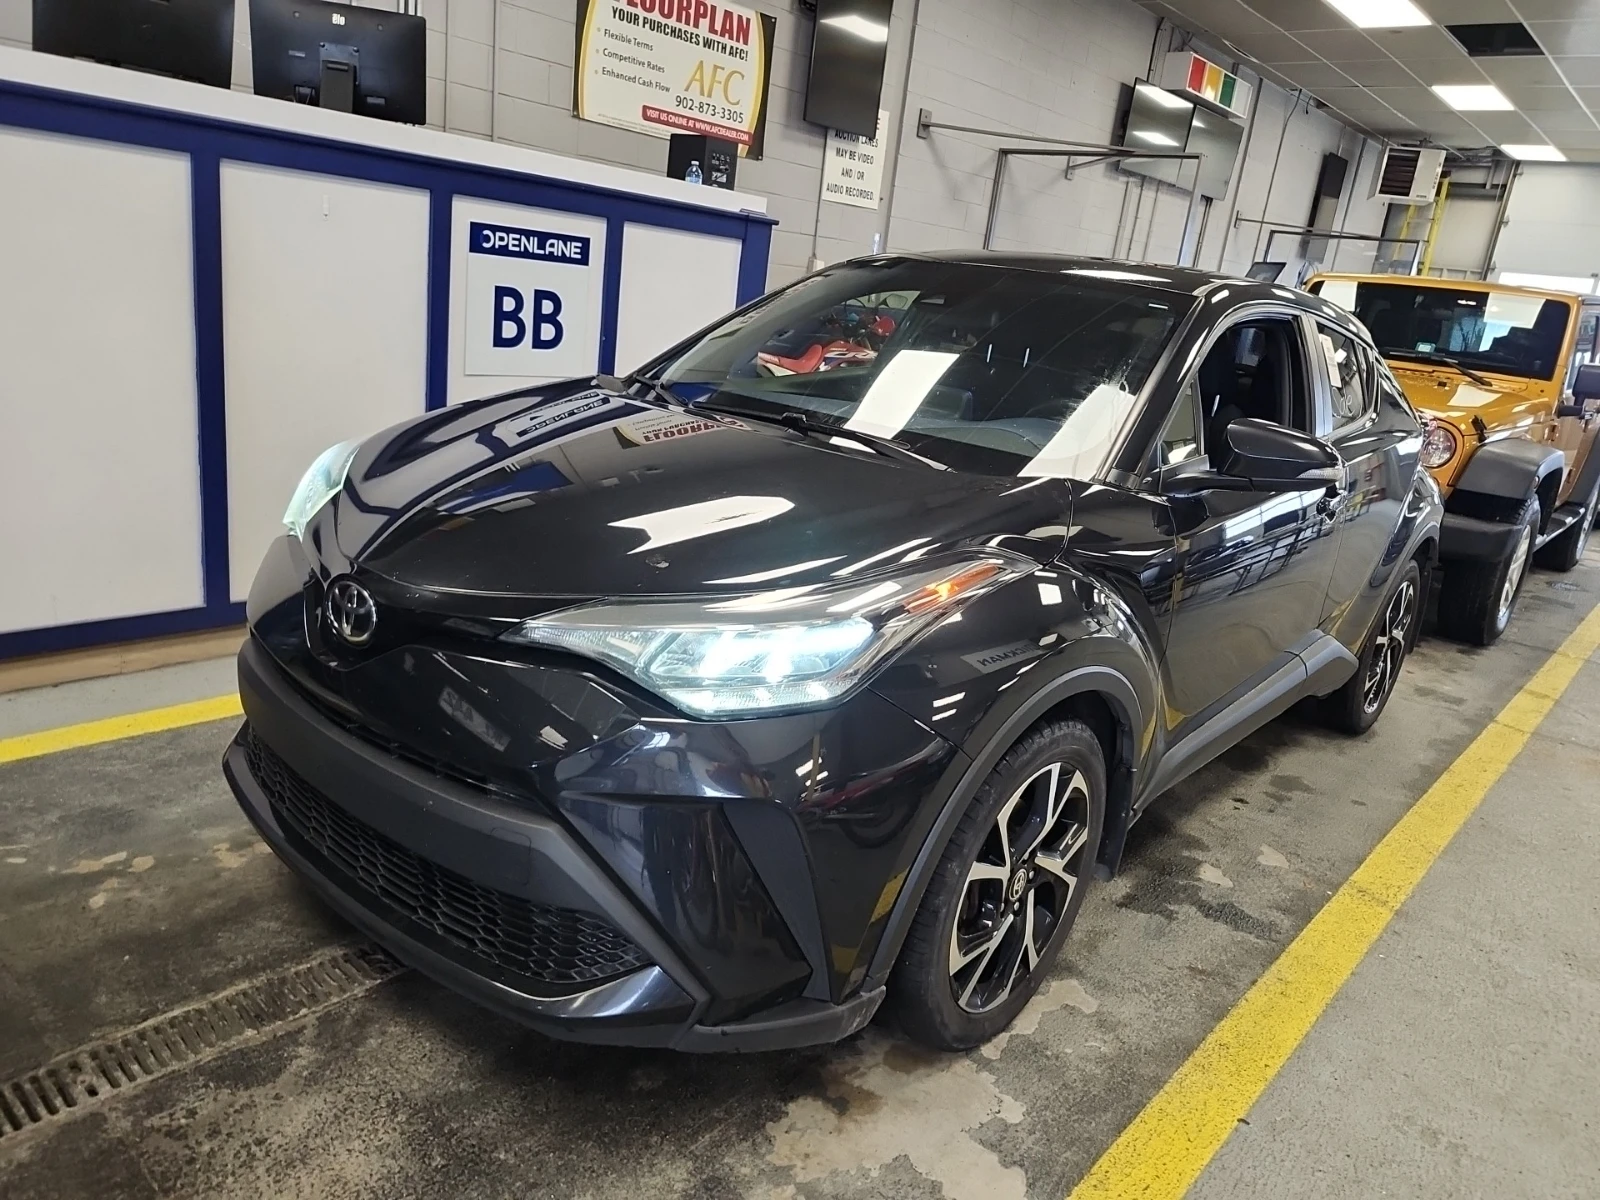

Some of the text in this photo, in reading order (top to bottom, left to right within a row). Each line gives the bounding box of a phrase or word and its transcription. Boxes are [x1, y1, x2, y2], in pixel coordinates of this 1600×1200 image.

[612, 6, 749, 62] YOUR PURCHASES WITH AFC!
[613, 0, 751, 46] ORPLAN
[604, 28, 654, 51] Flexible Terms
[603, 48, 665, 74] Competitive Rates
[602, 66, 671, 93] Enhanced Cash Flow
[684, 60, 745, 106] AFC
[646, 108, 659, 119] VISIT
[660, 112, 668, 121] US
[668, 114, 688, 127] ONLINE
[688, 119, 695, 128] AT
[675, 95, 745, 124] 902-873-3305
[836, 147, 874, 165] MAY BE VIDEO
[841, 167, 853, 178] AND
[857, 170, 865, 181] OR
[826, 182, 874, 201] AUDIO RECORDED.
[480, 229, 582, 259] OPENLANE
[493, 285, 564, 350] BB
